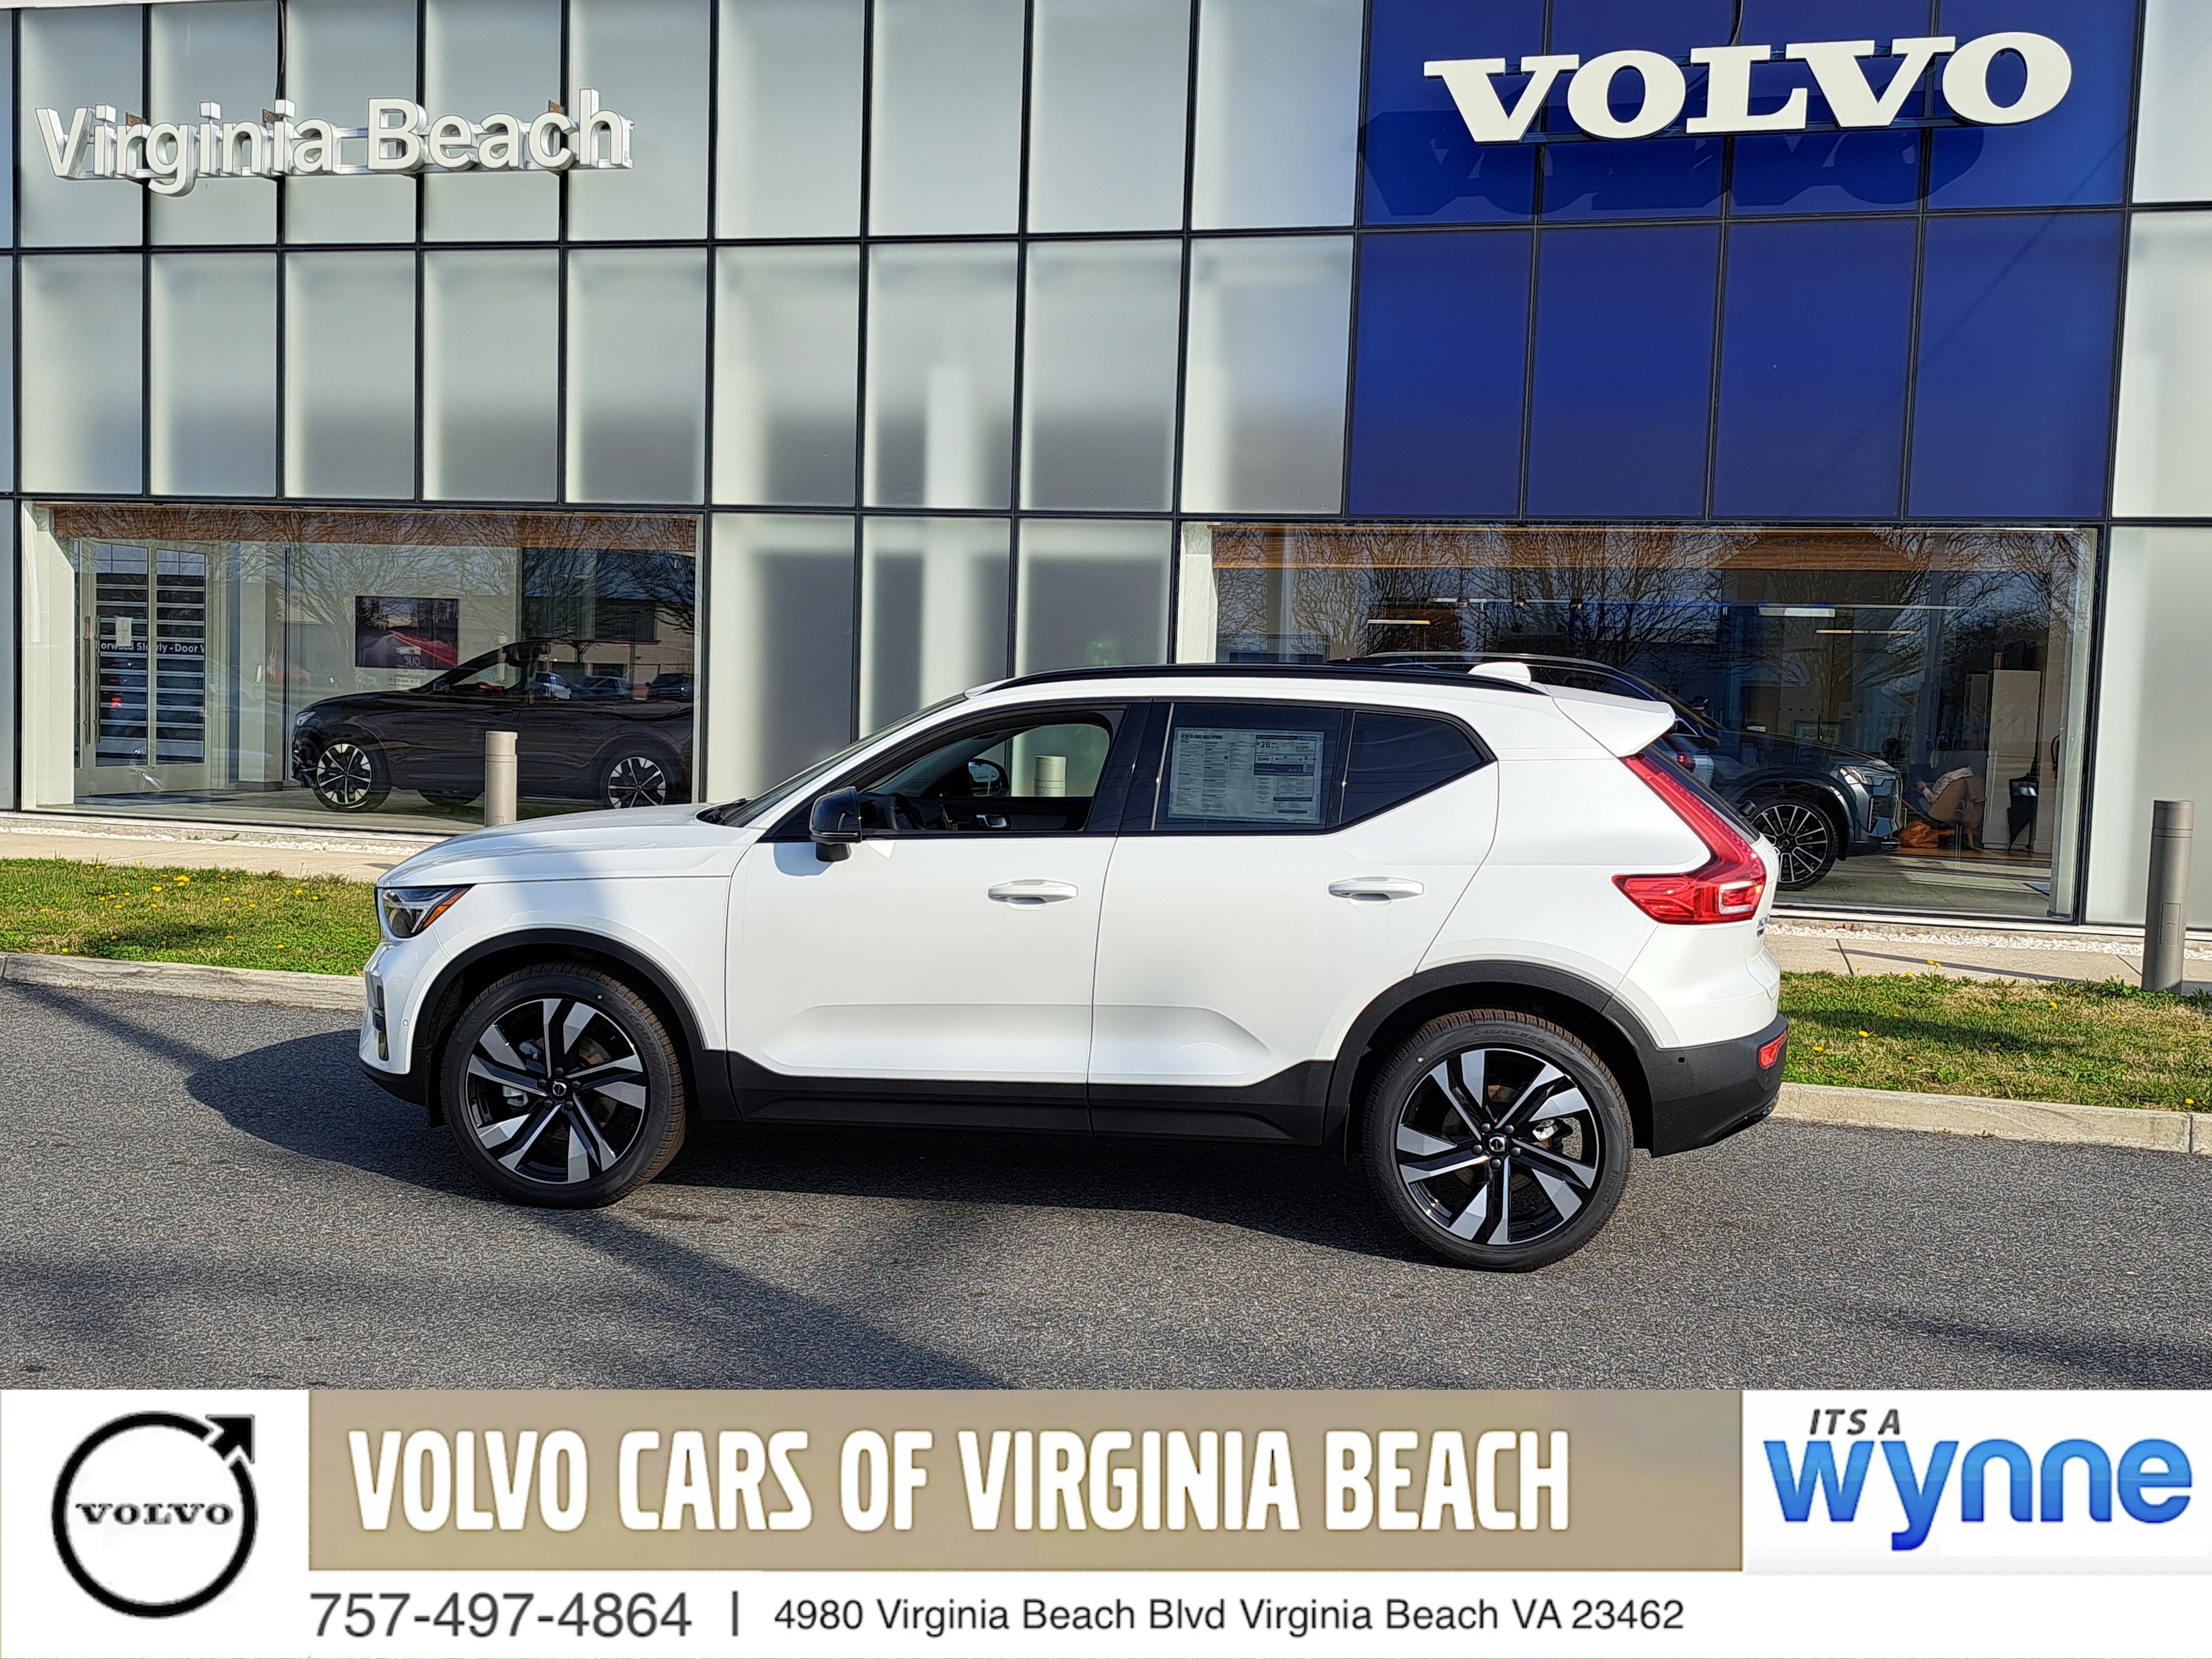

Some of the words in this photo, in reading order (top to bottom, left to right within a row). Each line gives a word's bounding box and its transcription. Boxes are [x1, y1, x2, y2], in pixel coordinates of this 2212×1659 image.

[1424, 32, 2072, 143] VOLVO
[35, 99, 340, 197] Virginia
[367, 88, 629, 171] Beach
[175, 643, 199, 653] Door
